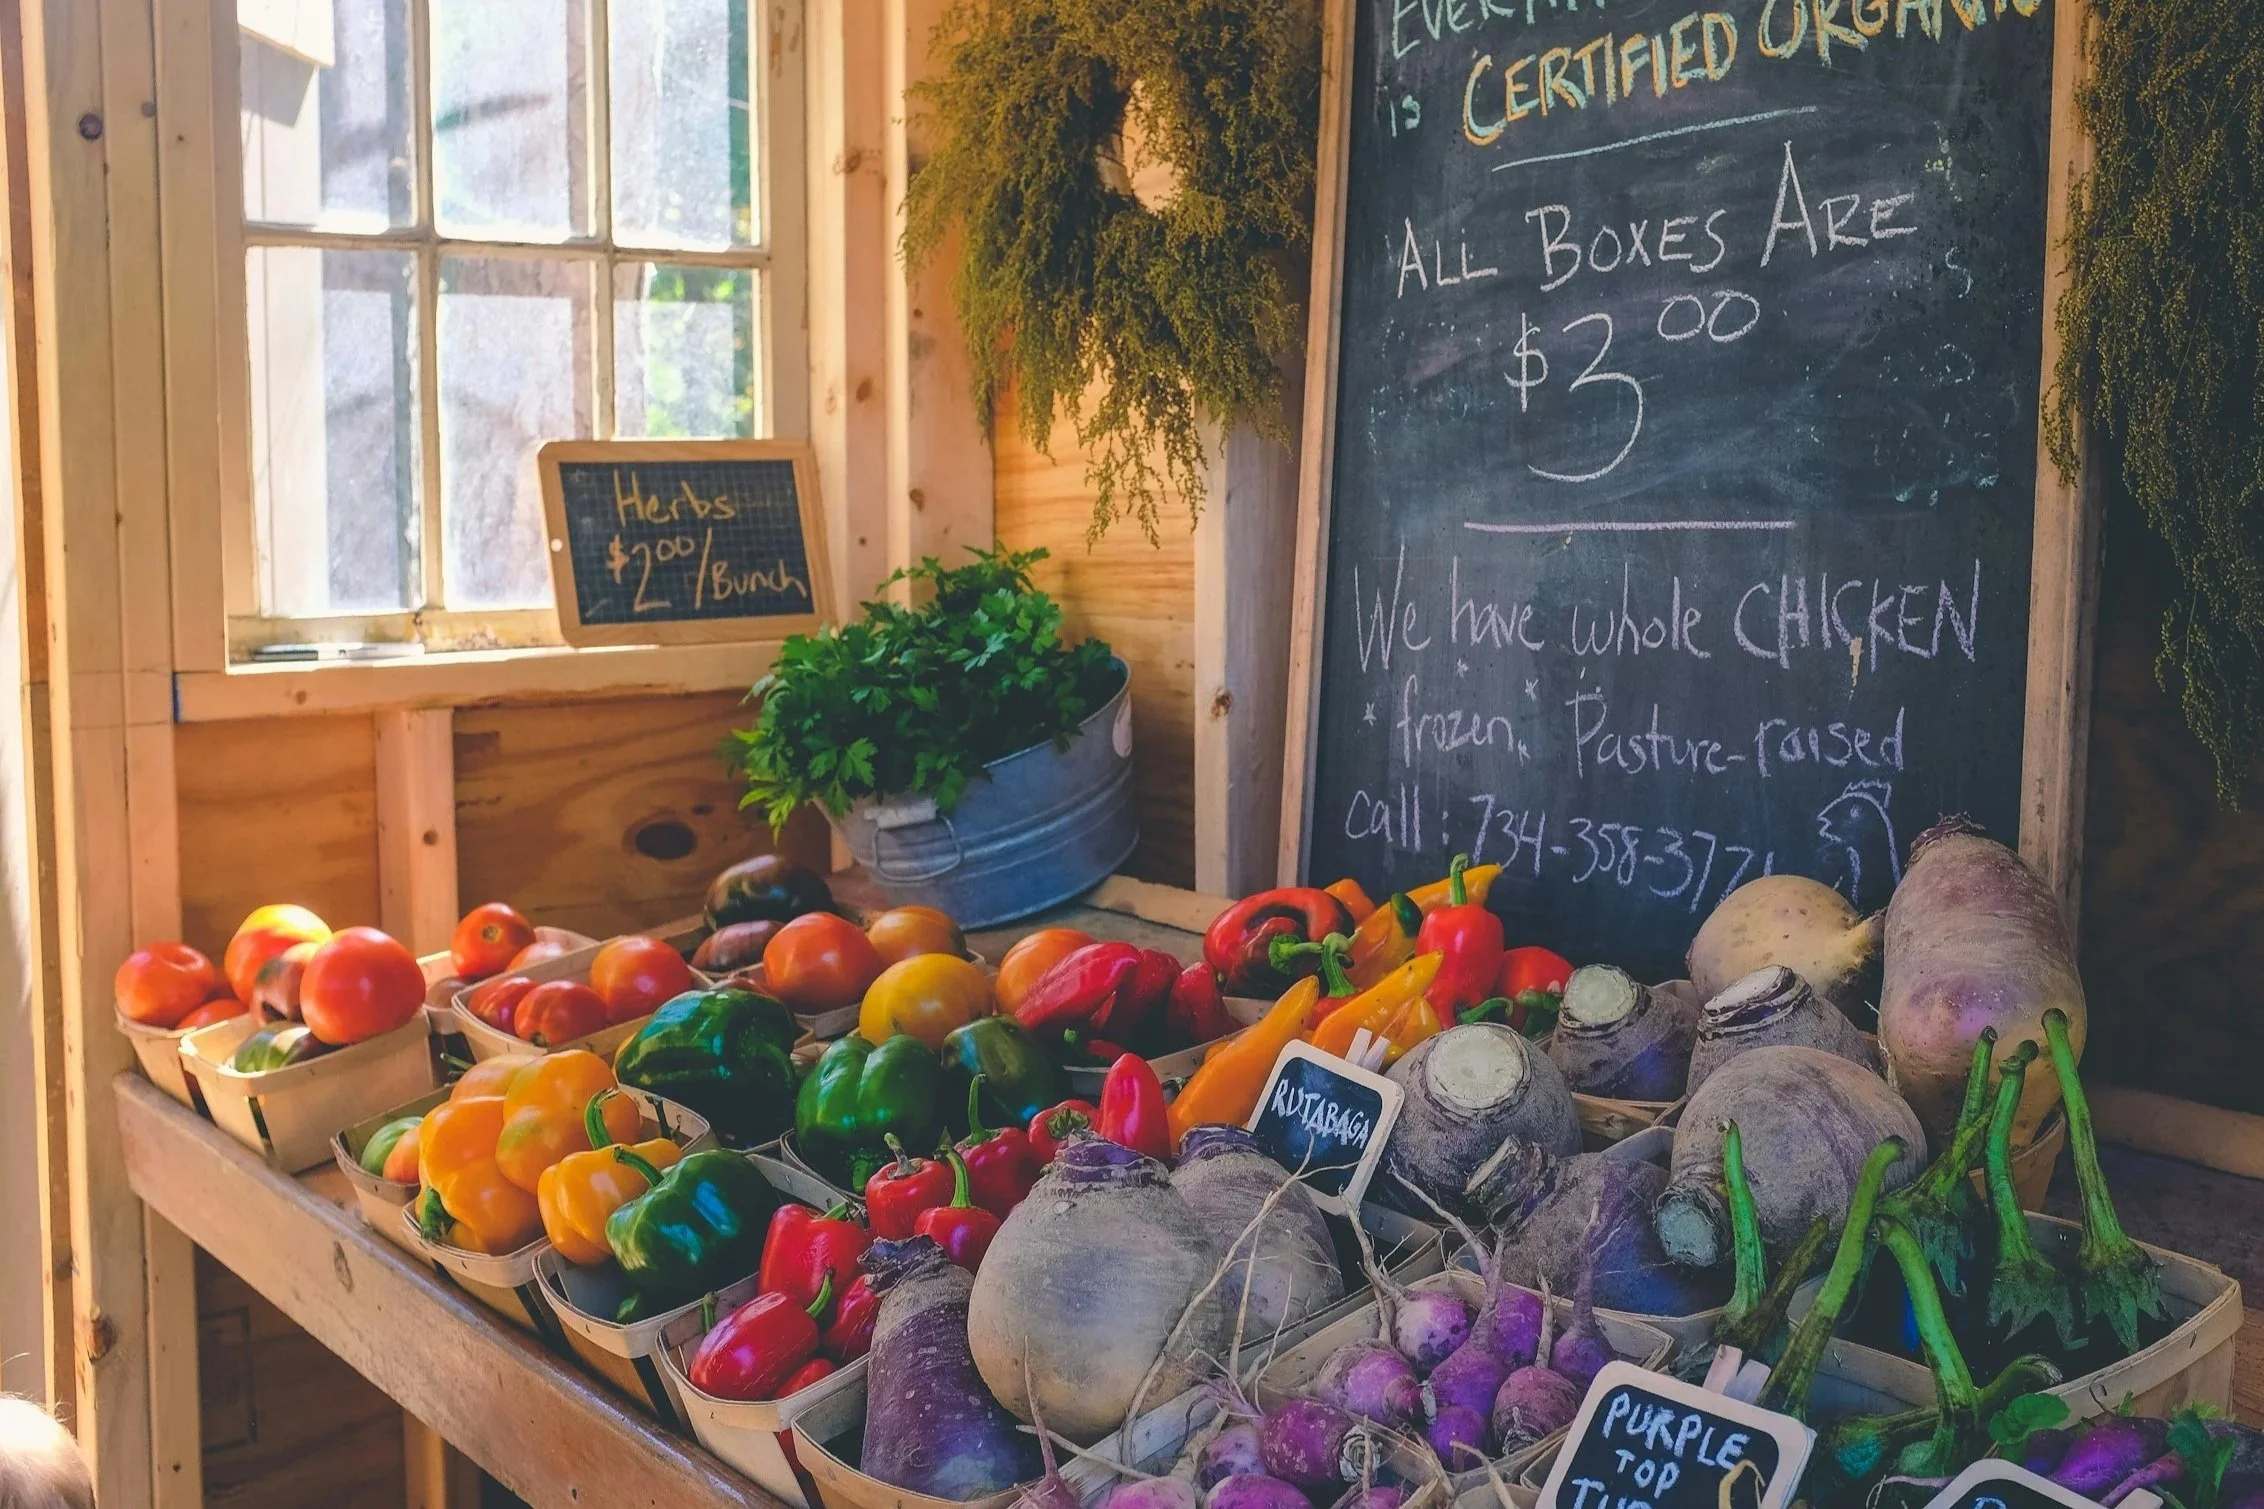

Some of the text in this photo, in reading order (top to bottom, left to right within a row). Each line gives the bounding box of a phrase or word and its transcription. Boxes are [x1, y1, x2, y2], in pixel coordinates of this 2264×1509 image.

[1463, 12, 1738, 146] CERTIFIED
[1757, 0, 2041, 68] ORGAN
[1396, 140, 1918, 298] ALL BOXES ARE
[613, 469, 736, 527] Herbs
[1354, 543, 1981, 674] We have whole CHICKEN
[1396, 673, 1514, 769] frozen
[1270, 1078, 1370, 1150] RUTABAGA
[1601, 1392, 1751, 1471] PURPLE
[1615, 1449, 1681, 1500] TOP
